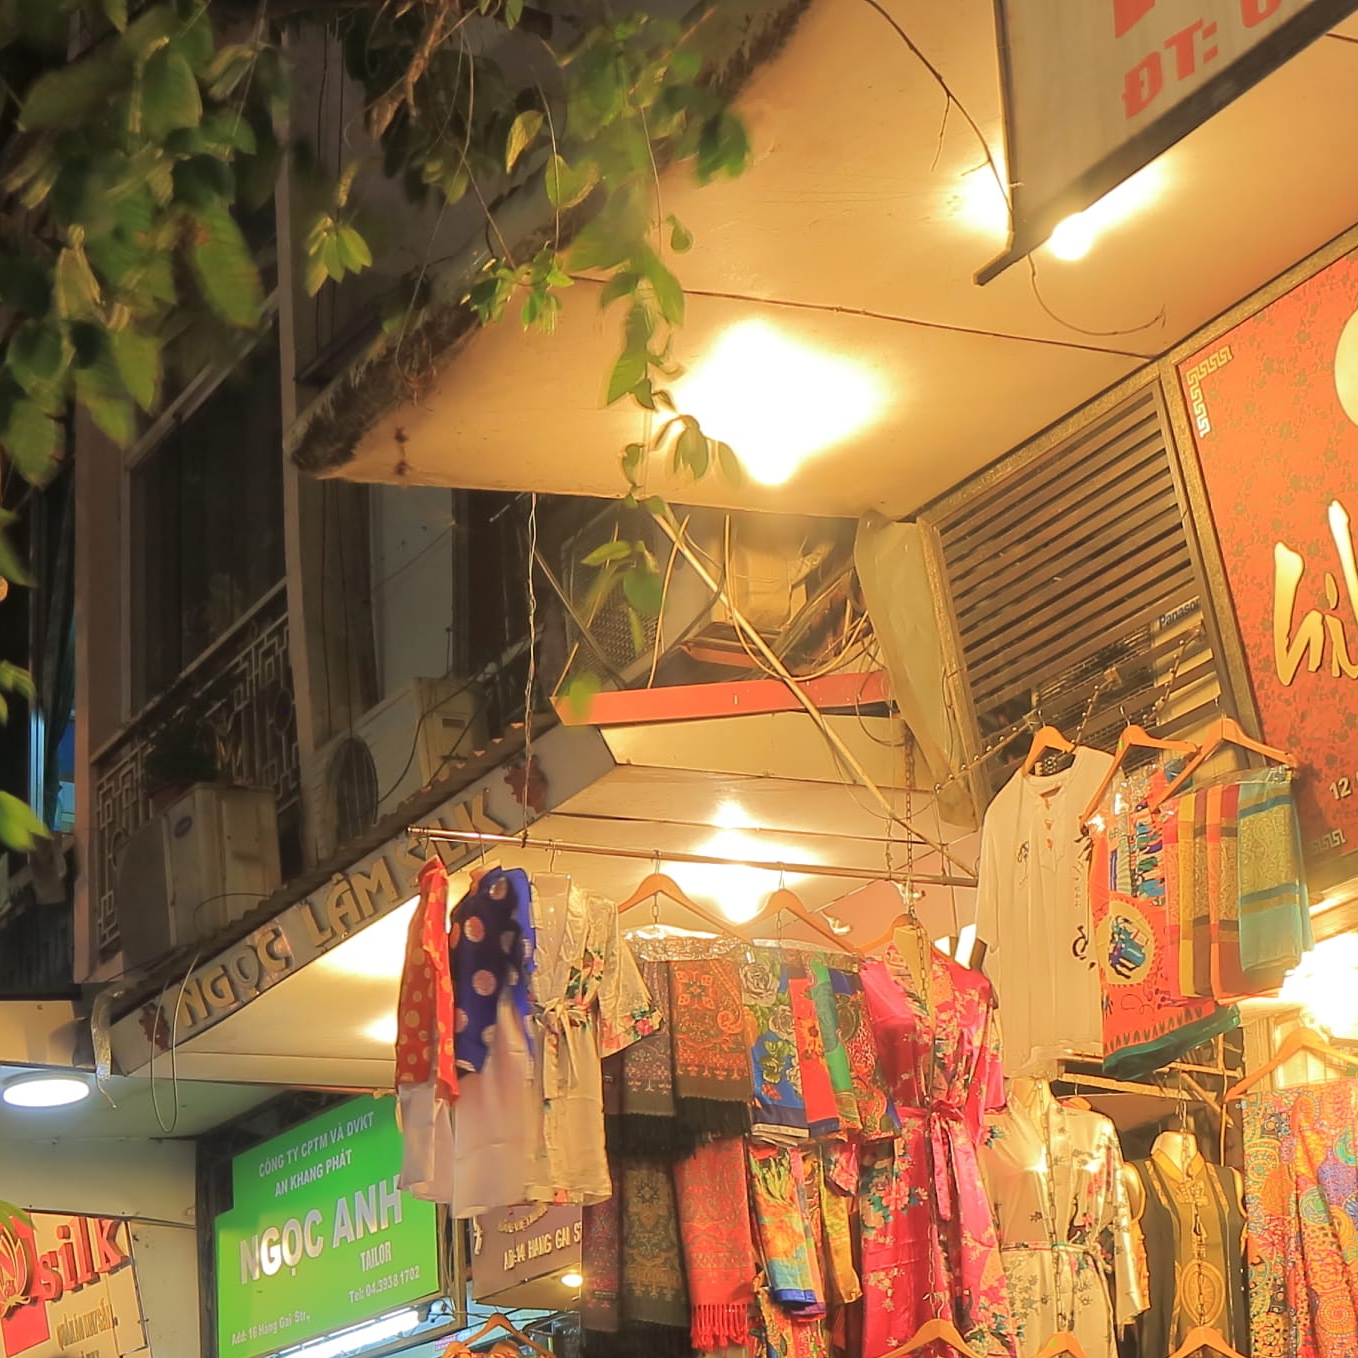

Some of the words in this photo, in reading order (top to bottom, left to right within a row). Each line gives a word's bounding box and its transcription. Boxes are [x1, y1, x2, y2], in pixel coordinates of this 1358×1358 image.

[1158, 598, 1201, 628] Panaso
[1329, 776, 1352, 800] 12
[170, 926, 291, 1028] NGỌC
[299, 856, 398, 947] LÂM
[286, 1146, 300, 1165] TY
[275, 1178, 289, 1198] AN
[290, 1163, 324, 1191] KHANG
[239, 1207, 325, 1286] NGỌC
[331, 1174, 404, 1249] ANH
[359, 1240, 392, 1272] TAILOR
